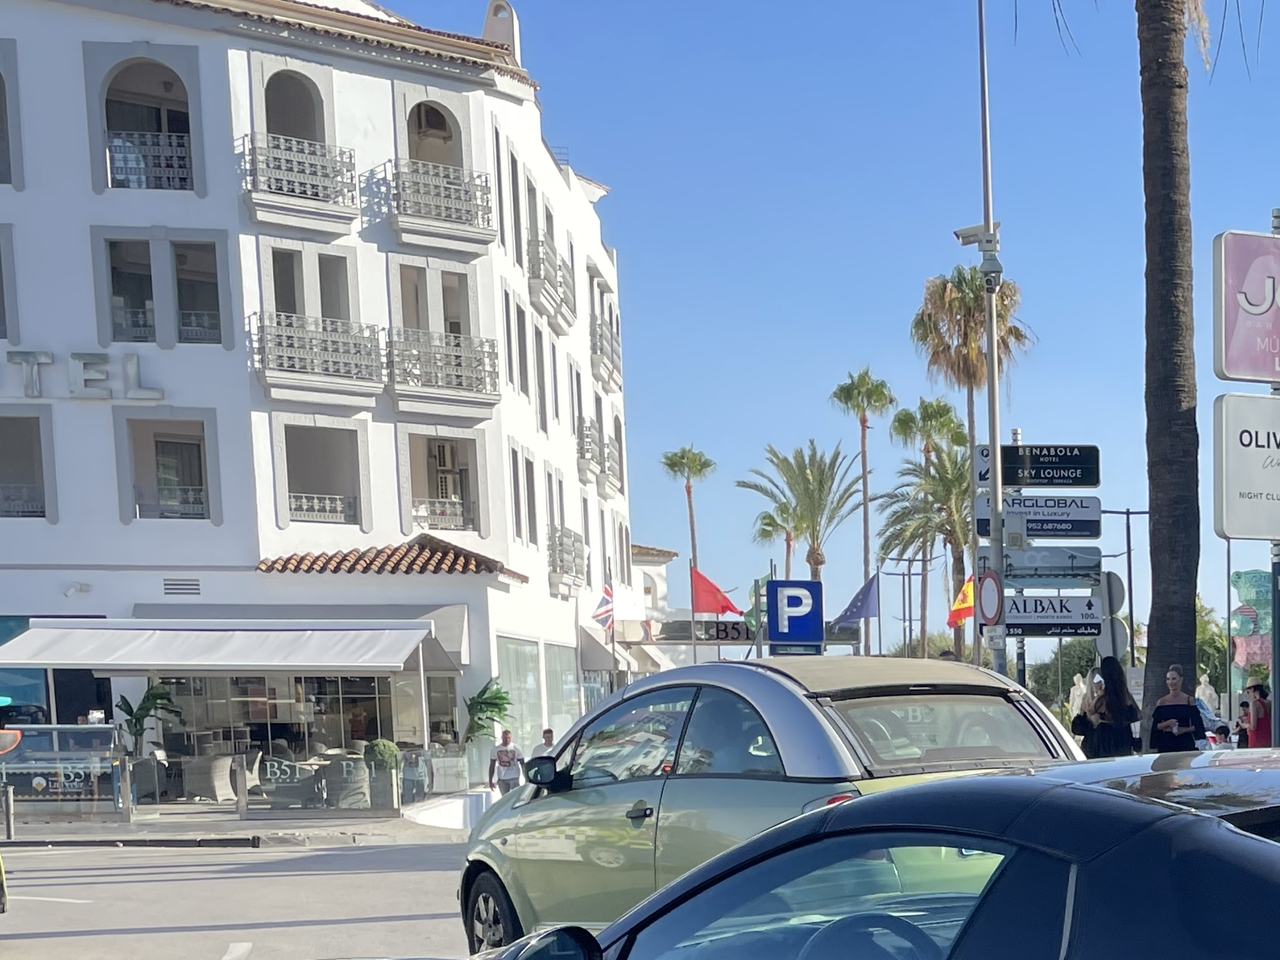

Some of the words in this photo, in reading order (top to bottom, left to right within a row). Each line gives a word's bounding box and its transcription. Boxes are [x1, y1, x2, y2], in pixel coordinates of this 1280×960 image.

[1018, 447, 1080, 456] BENABOLA
[1017, 469, 1036, 478] SKY
[1040, 469, 1082, 478] LOUNGE
[1239, 491, 1263, 500] NIGHT
[986, 498, 1090, 509] ARGLOBAL
[1042, 510, 1071, 518] Luxury
[777, 587, 813, 633] P
[266, 761, 300, 779] B51
